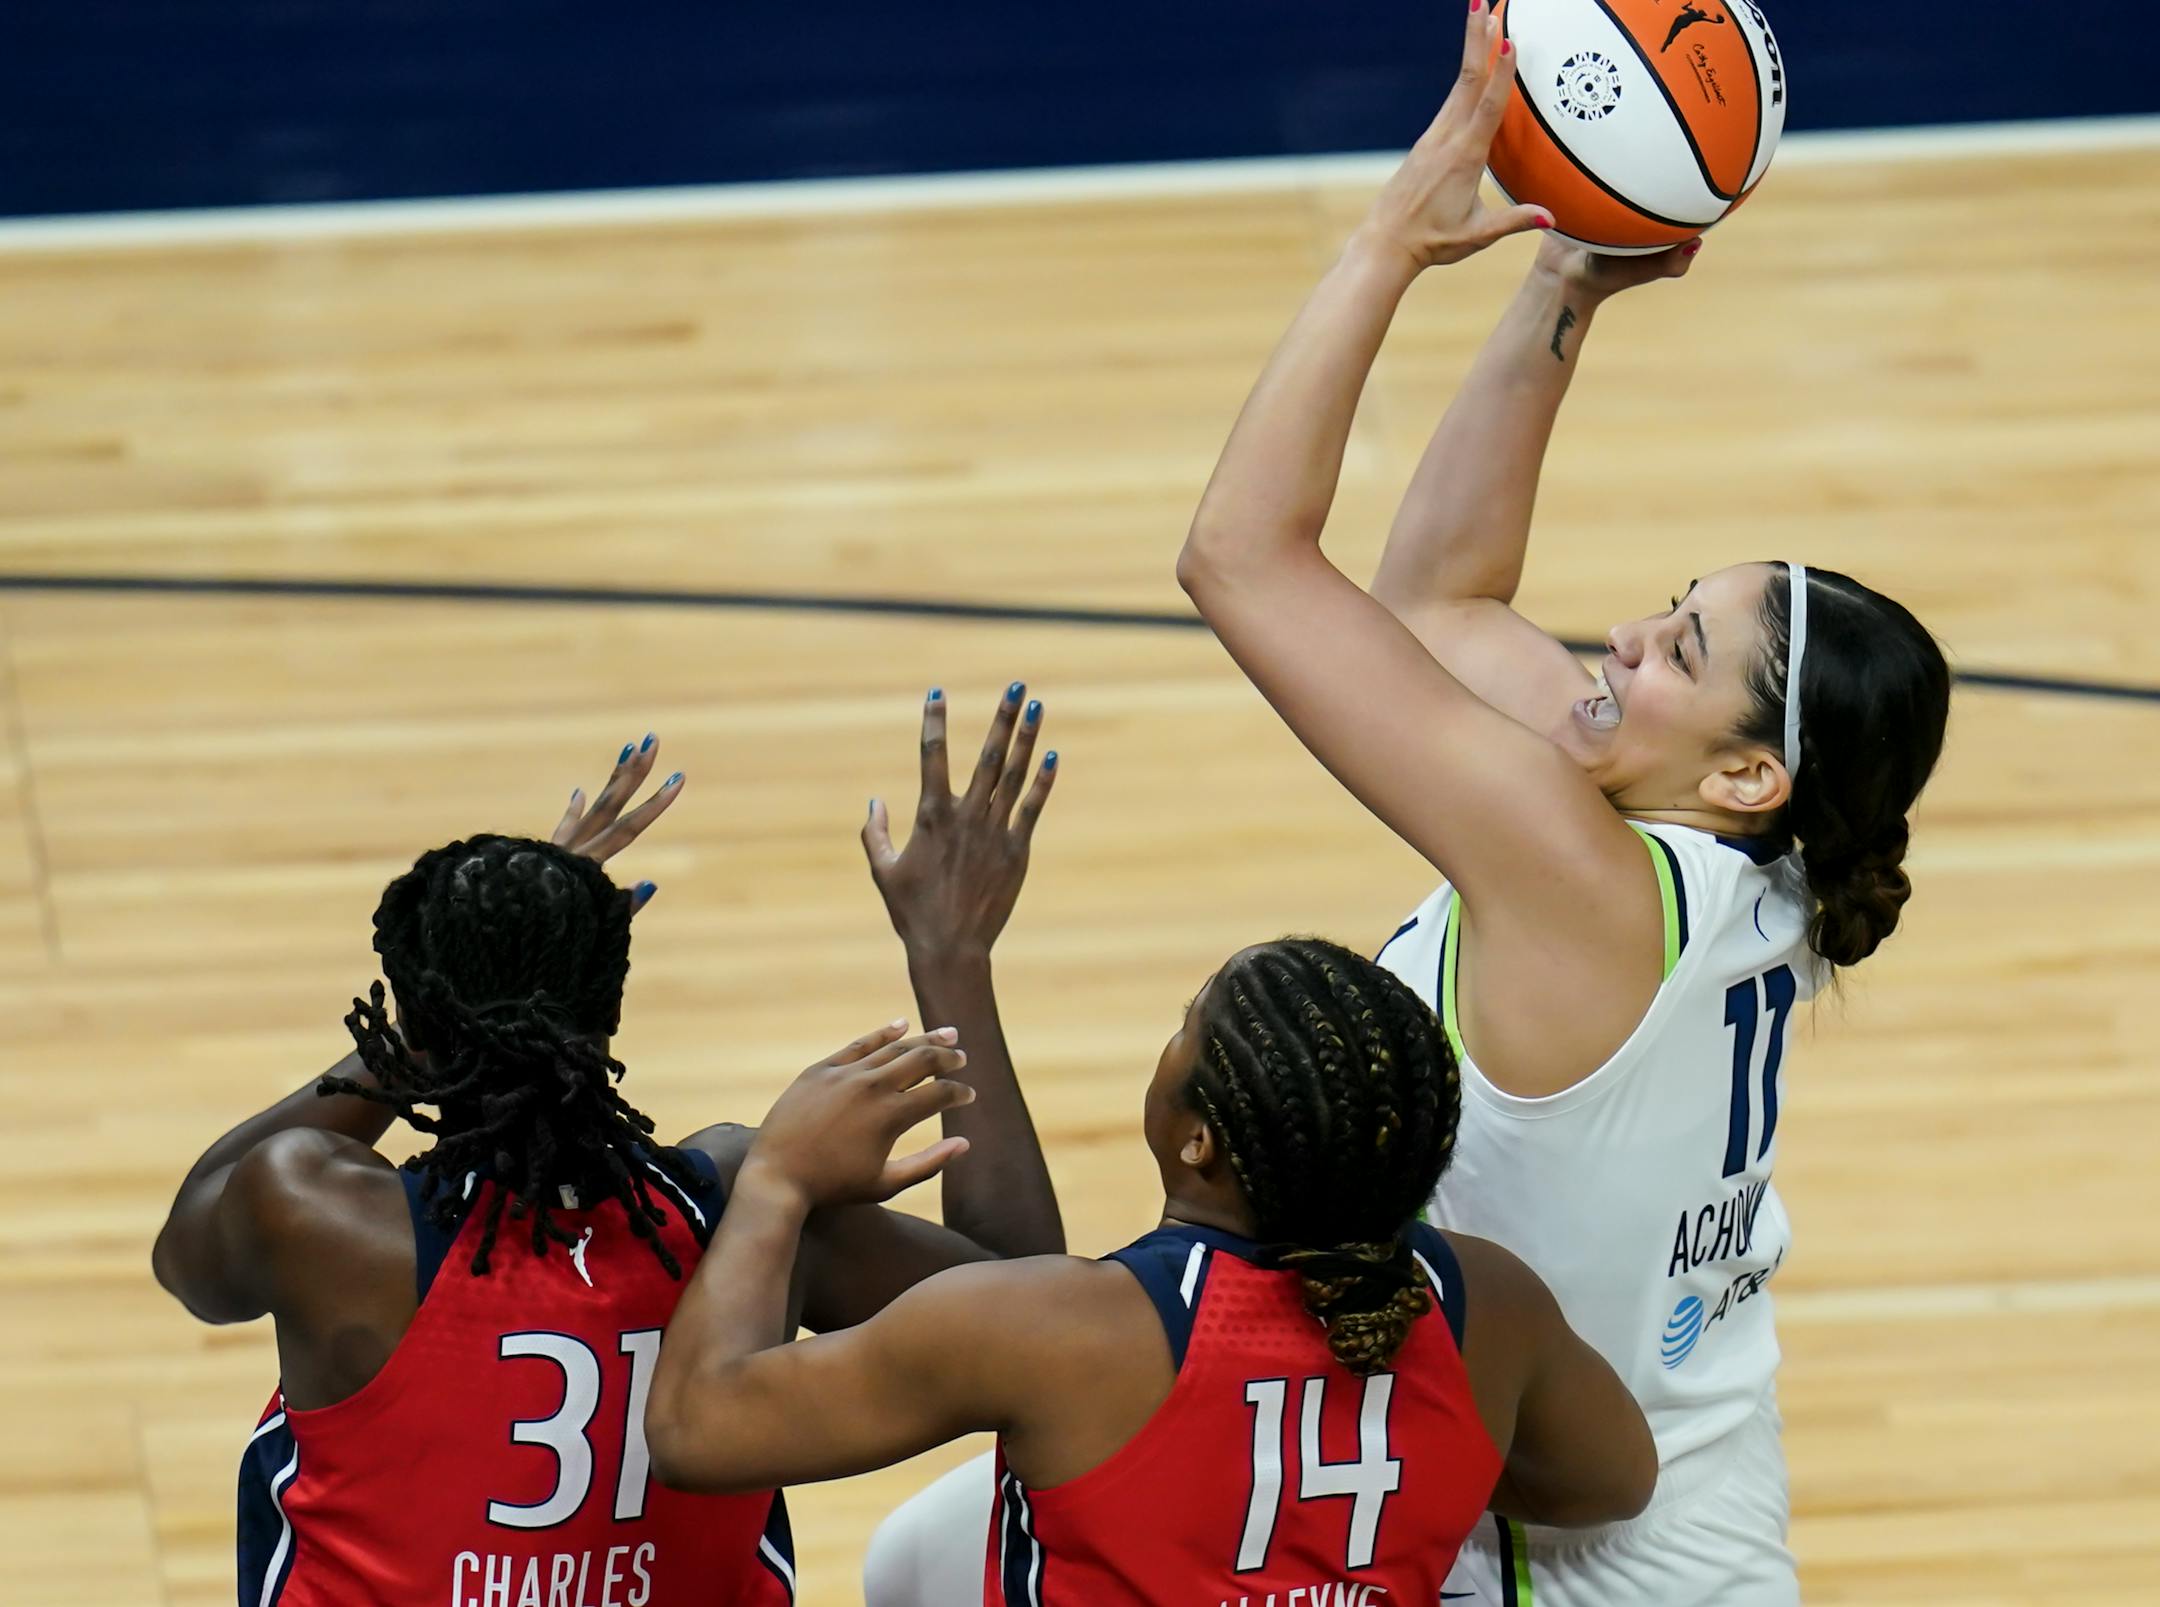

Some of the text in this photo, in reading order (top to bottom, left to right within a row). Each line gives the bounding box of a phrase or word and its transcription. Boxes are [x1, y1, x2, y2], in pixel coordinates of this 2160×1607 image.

[1722, 963, 1796, 1179] 11
[486, 1327, 663, 1533] 31
[1234, 1371, 1404, 1574] 14
[452, 1541, 656, 1607] CHARLES
